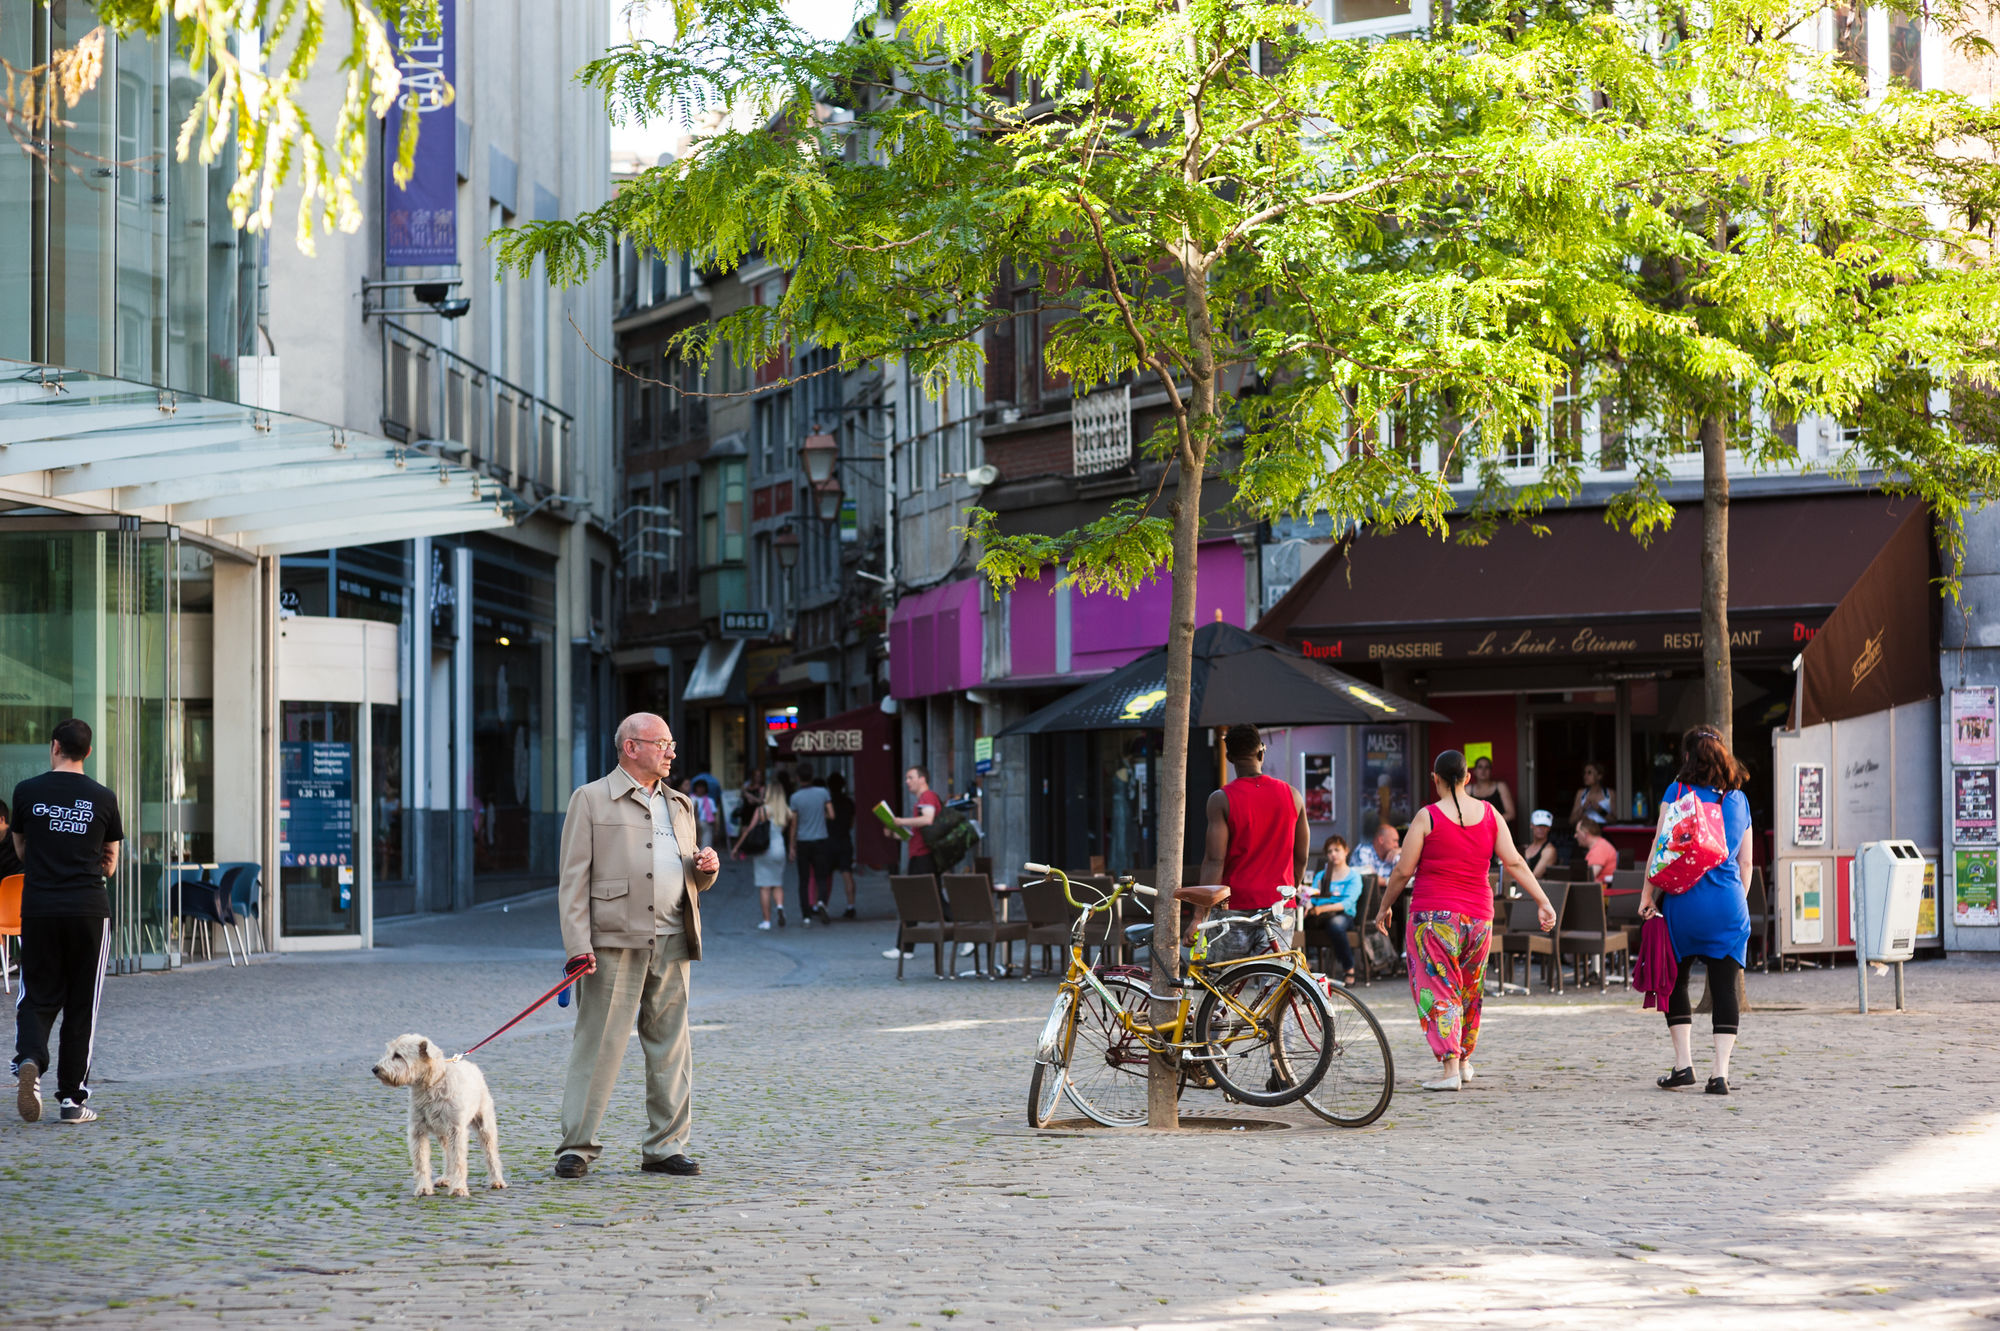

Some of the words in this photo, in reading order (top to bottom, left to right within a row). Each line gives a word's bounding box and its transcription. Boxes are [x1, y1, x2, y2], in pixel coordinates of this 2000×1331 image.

[726, 615, 765, 628] BASE
[1467, 631, 1497, 655] Le
[1502, 629, 1556, 655] Saint
[1663, 630, 1762, 649] RESTANT
[1302, 640, 1342, 659] Duvel
[1368, 642, 1443, 659] BRASSERIE
[791, 729, 863, 752] ANDRE
[1367, 734, 1397, 751] MAES
[49, 819, 87, 834] RAW
